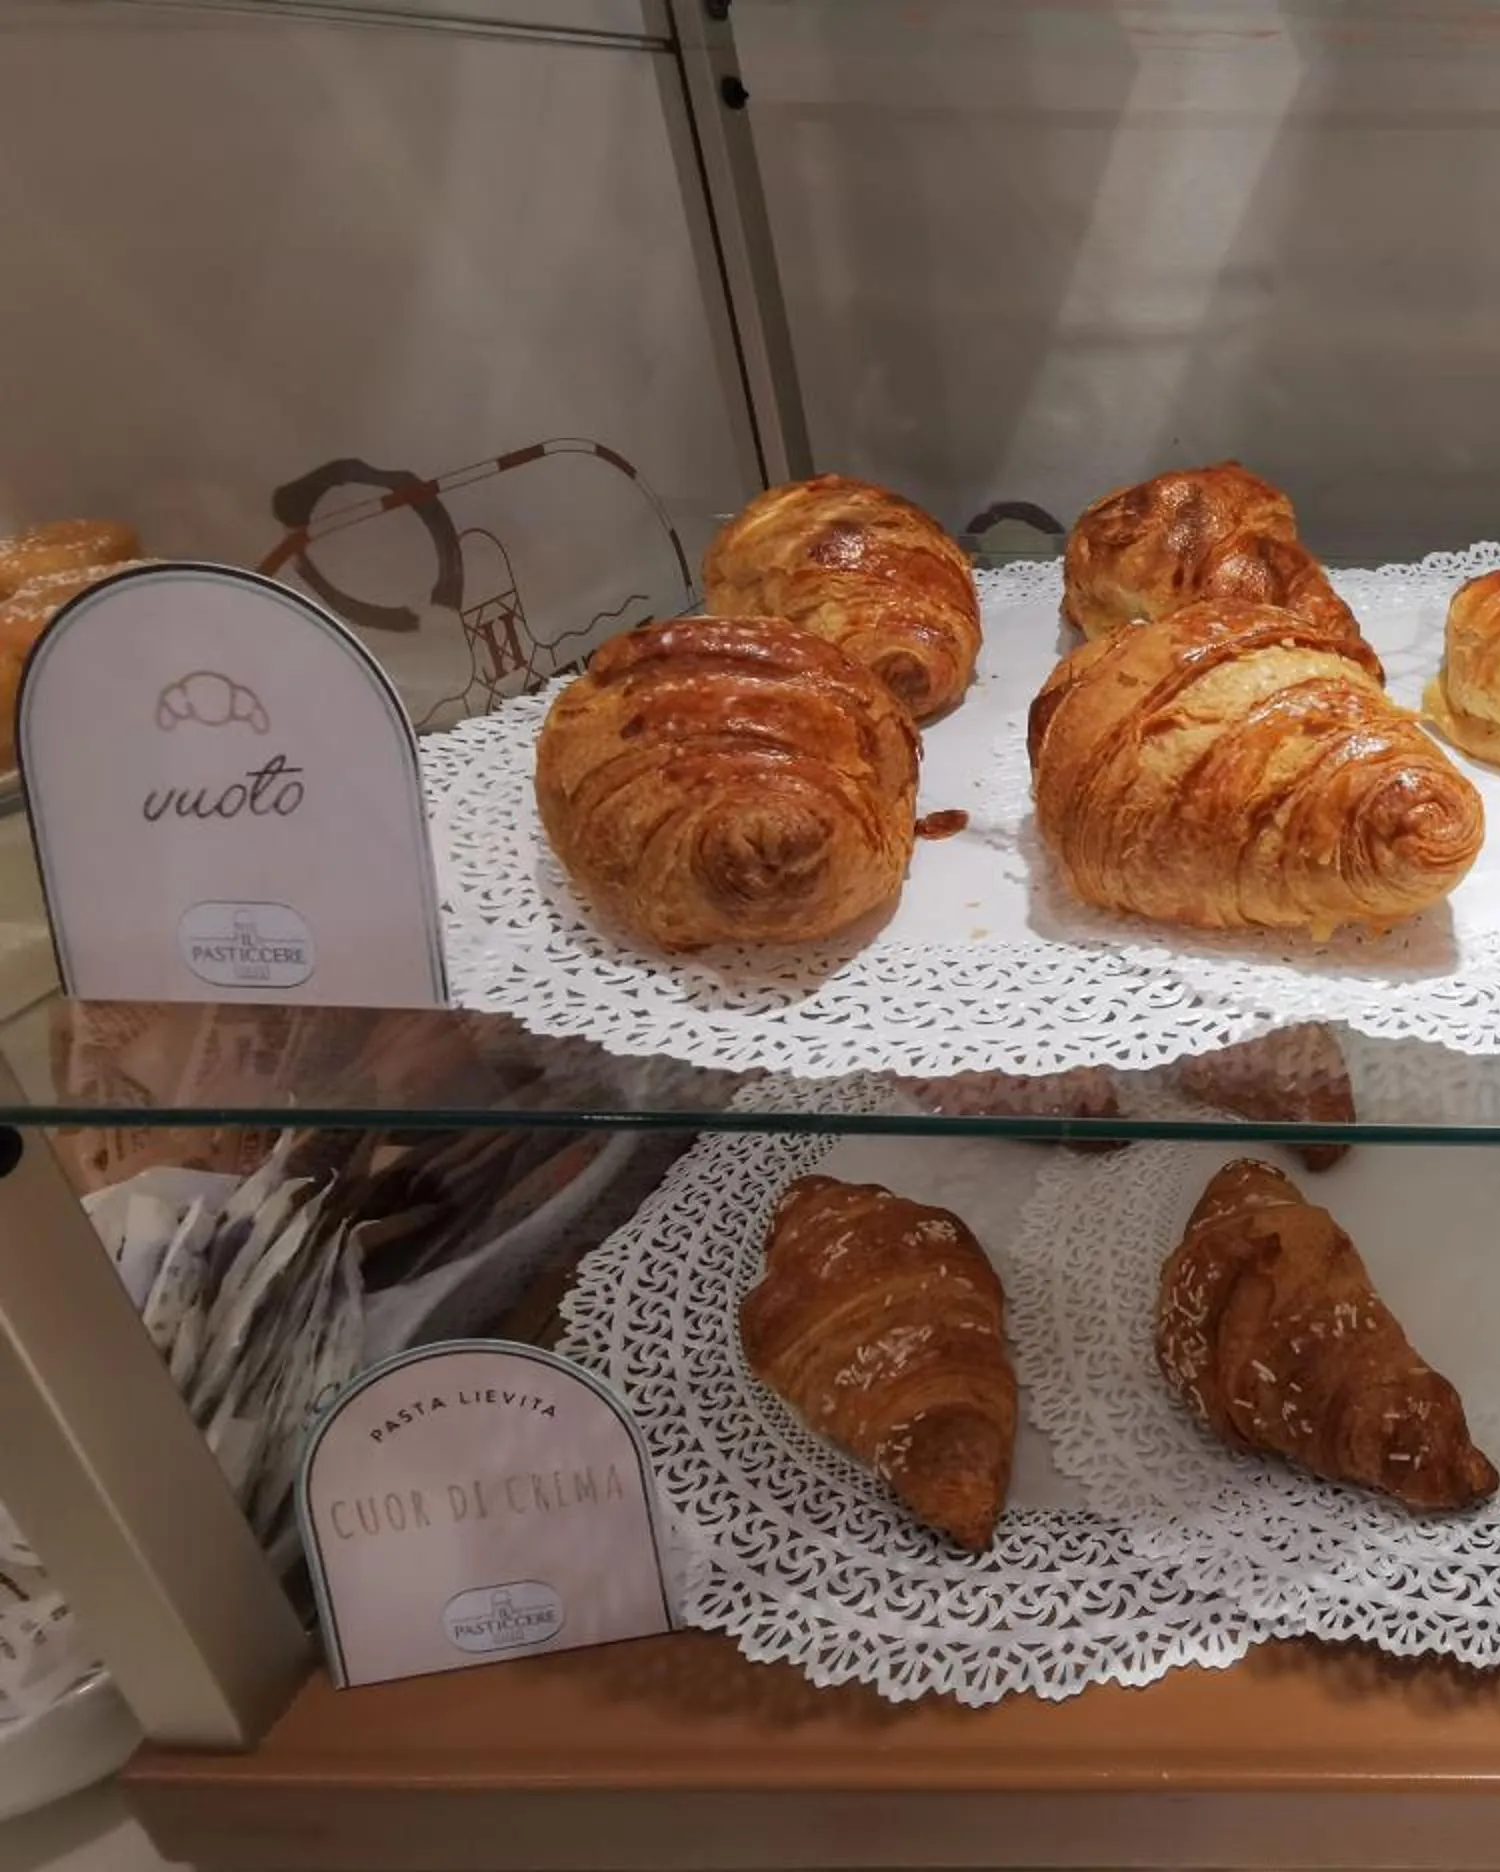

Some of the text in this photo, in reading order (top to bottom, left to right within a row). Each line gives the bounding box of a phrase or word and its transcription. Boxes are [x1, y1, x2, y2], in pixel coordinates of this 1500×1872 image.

[144, 754, 304, 822] vuoto
[370, 1390, 556, 1443] PASTA LIEVITA
[331, 1463, 623, 1540] CUOR DI CREMA
